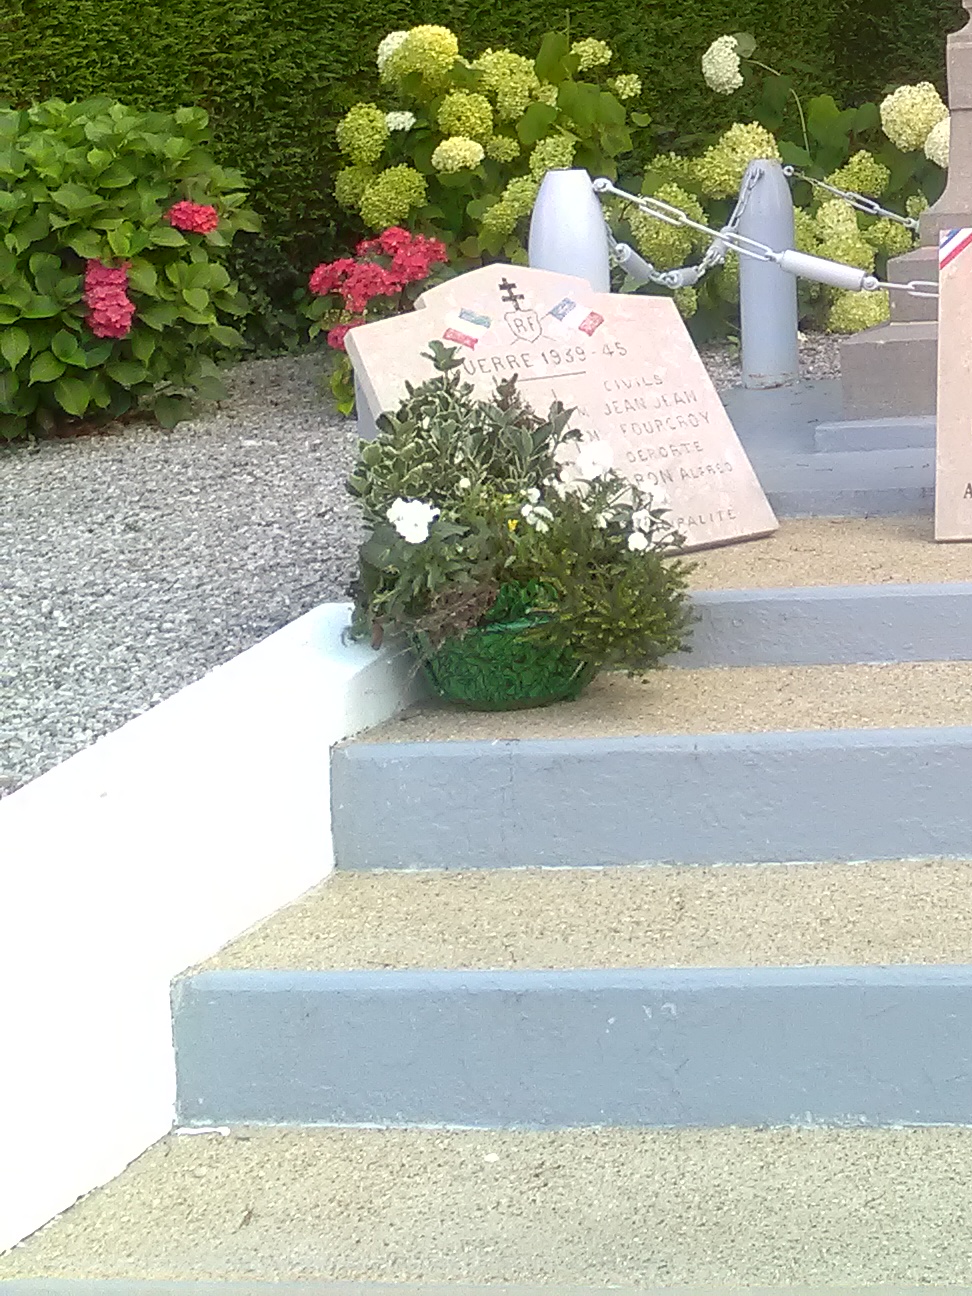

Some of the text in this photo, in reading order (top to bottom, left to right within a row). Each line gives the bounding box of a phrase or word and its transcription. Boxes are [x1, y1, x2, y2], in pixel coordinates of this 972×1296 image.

[513, 315, 535, 334] RF
[462, 352, 535, 376] UERRE
[604, 397, 648, 416] JEAN
[654, 390, 698, 410] JEAN
[619, 410, 711, 436] FOURCROY
[633, 467, 674, 486] RON
